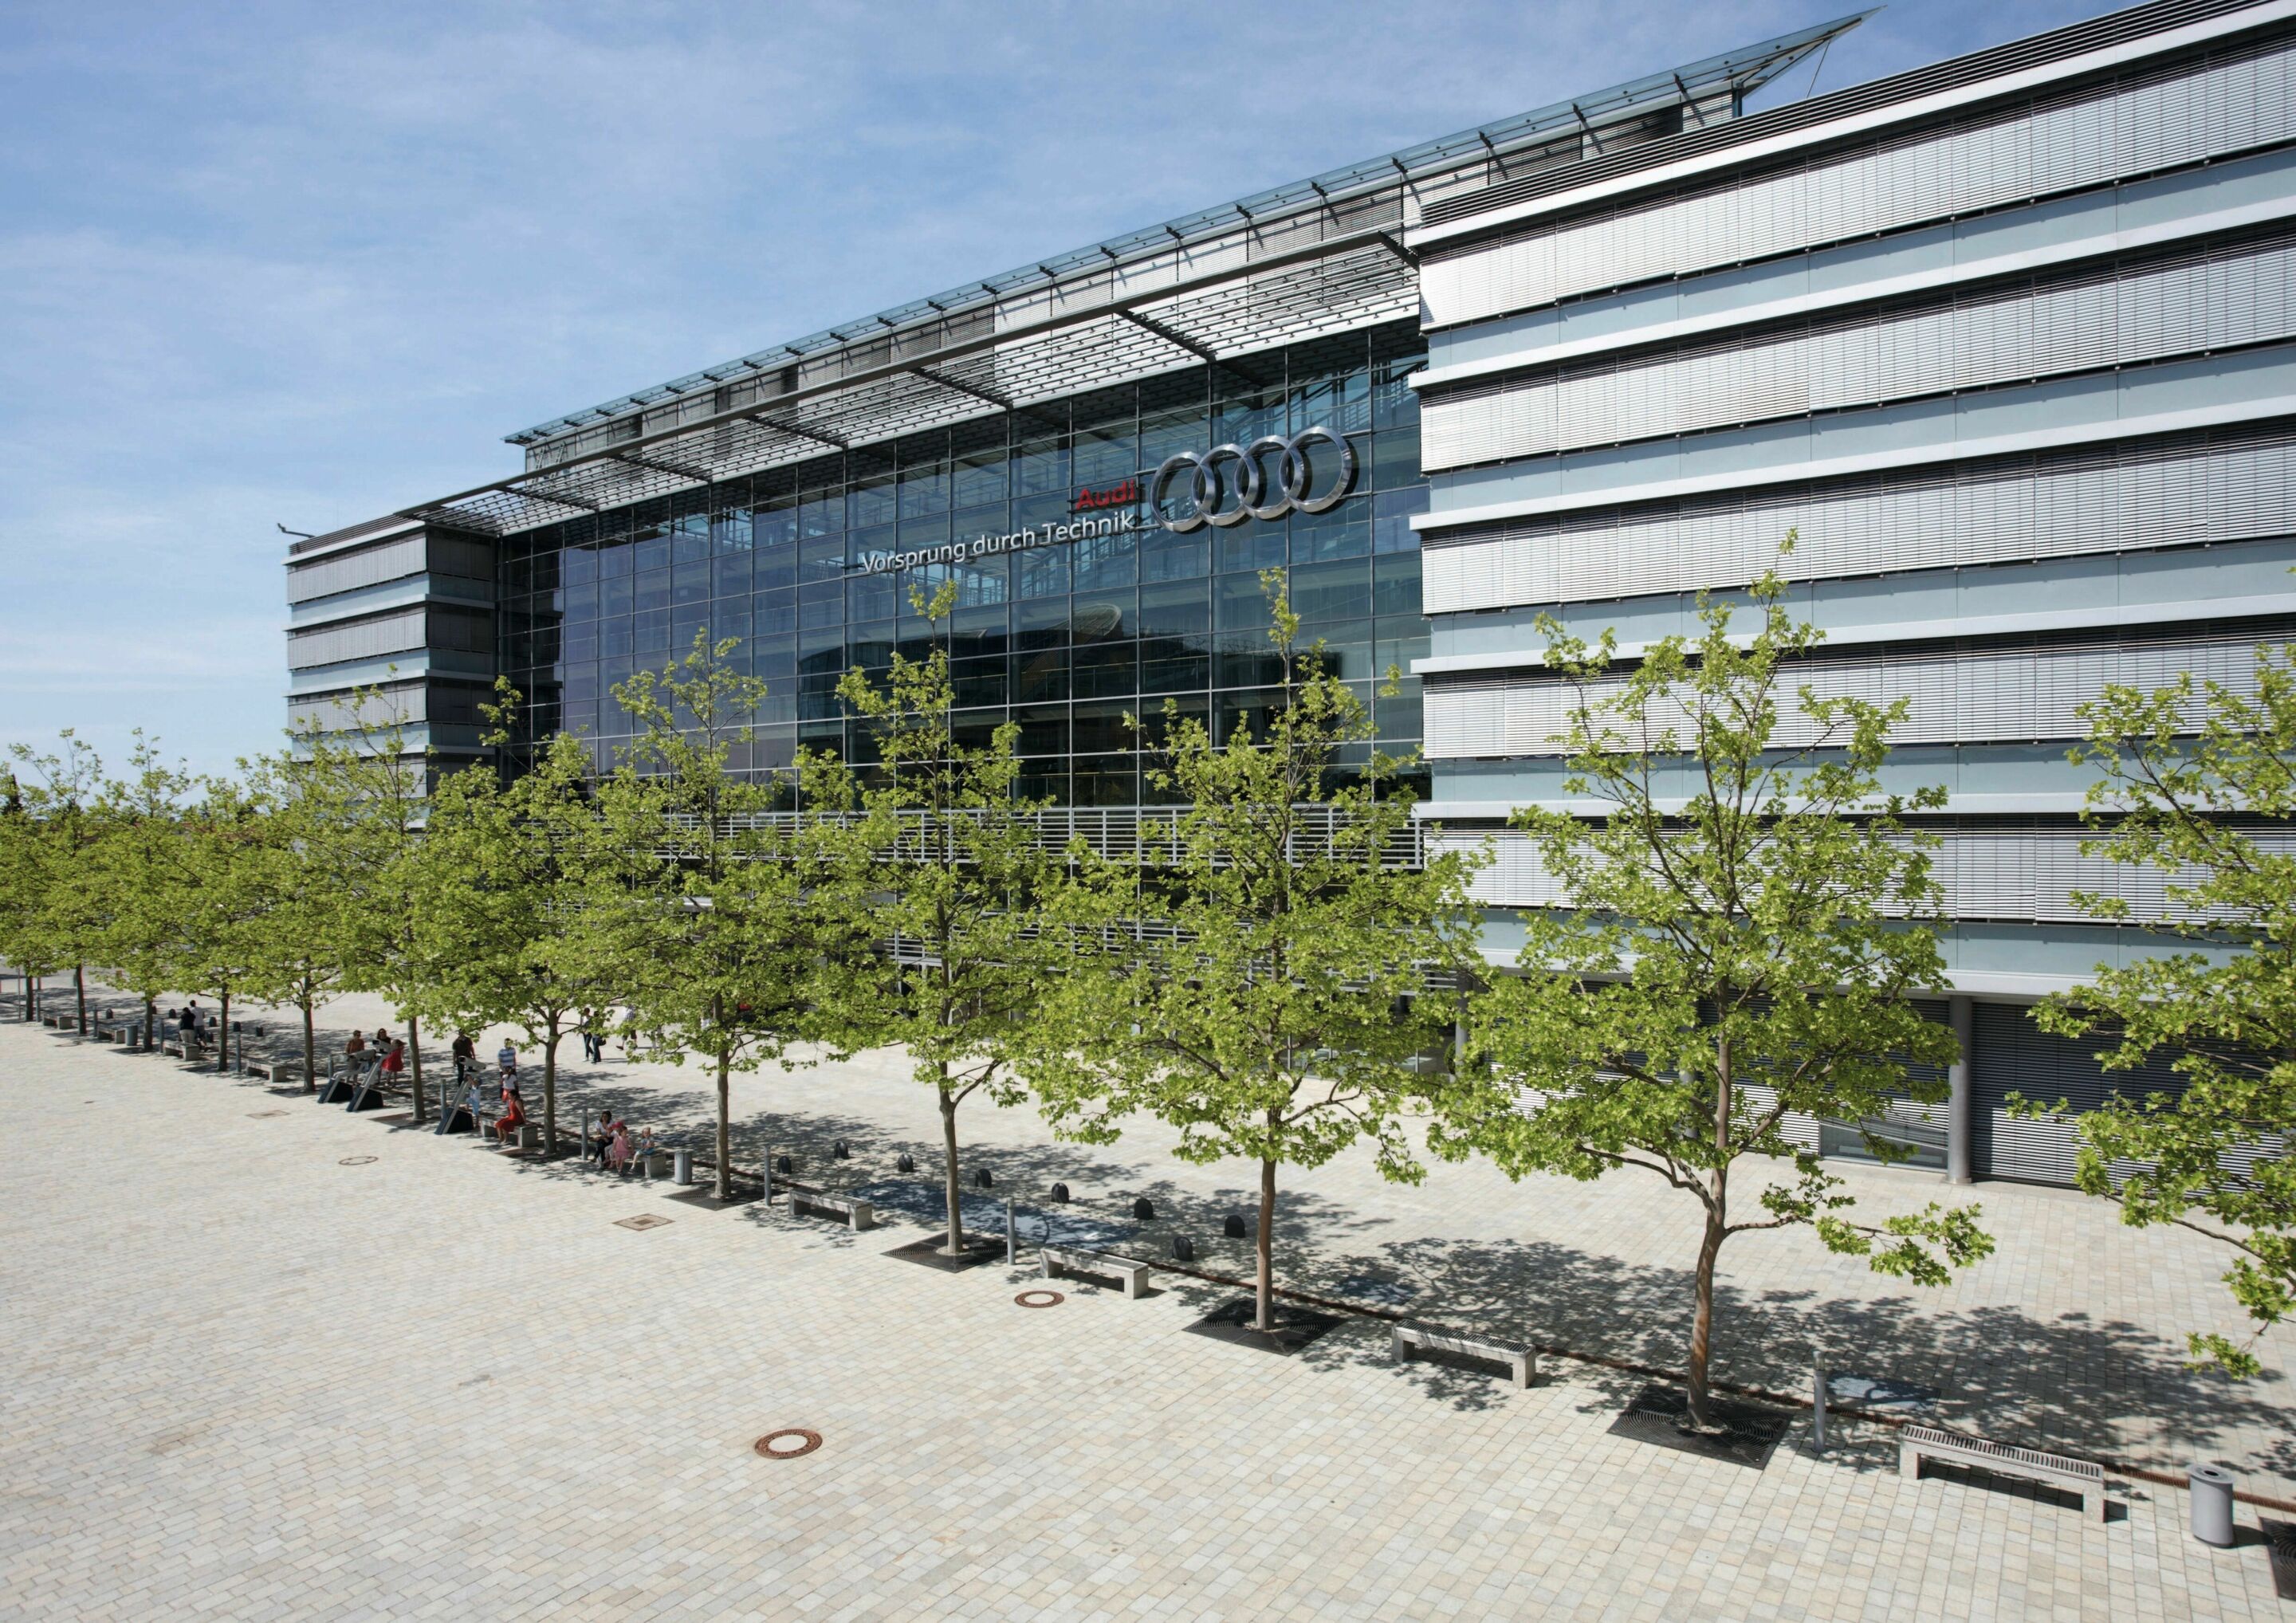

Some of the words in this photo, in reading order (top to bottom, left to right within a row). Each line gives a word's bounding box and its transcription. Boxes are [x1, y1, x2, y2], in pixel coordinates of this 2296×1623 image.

[1075, 479, 1135, 510] Audi
[863, 542, 965, 572] Vorsprung
[973, 527, 1036, 554] durch
[1041, 510, 1135, 543] Technik
